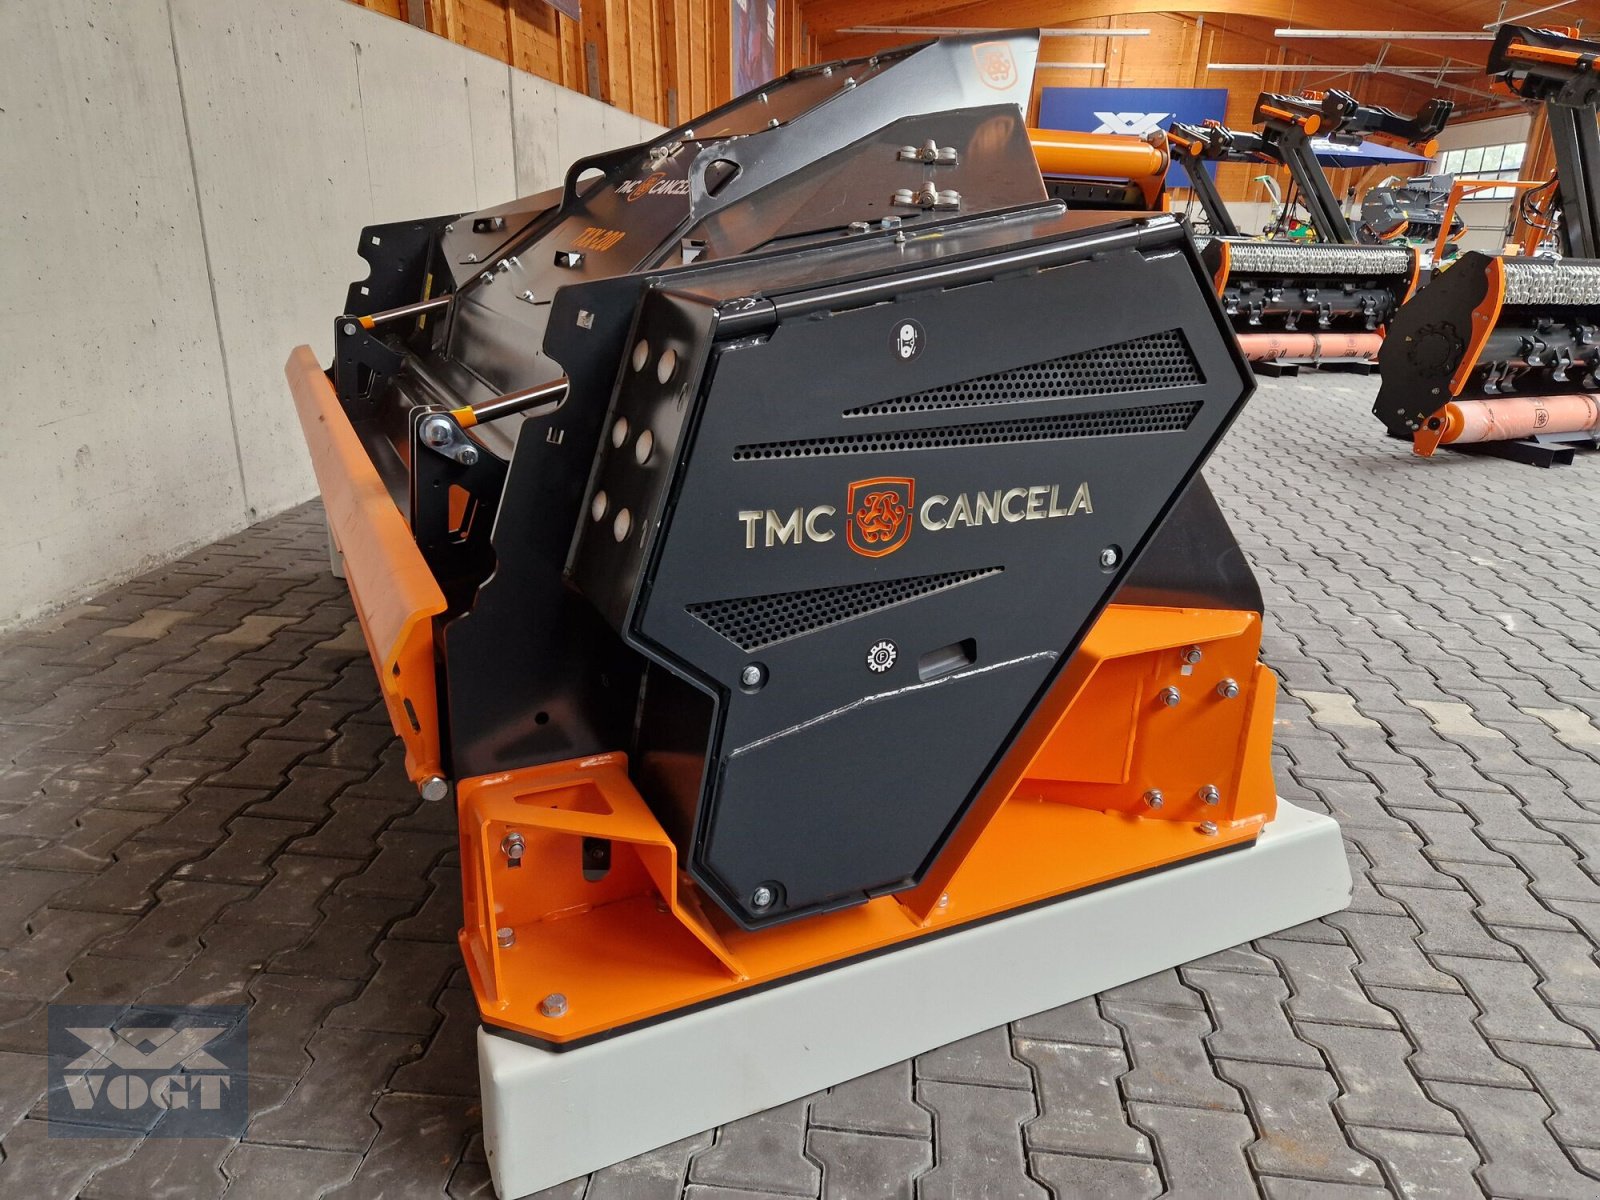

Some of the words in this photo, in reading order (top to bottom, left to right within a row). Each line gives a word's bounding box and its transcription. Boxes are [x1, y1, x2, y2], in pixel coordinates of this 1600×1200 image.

[614, 180, 642, 194] TMC
[647, 180, 690, 194] CANCEL
[738, 505, 837, 549] TMC
[920, 482, 1093, 531] CANCELA
